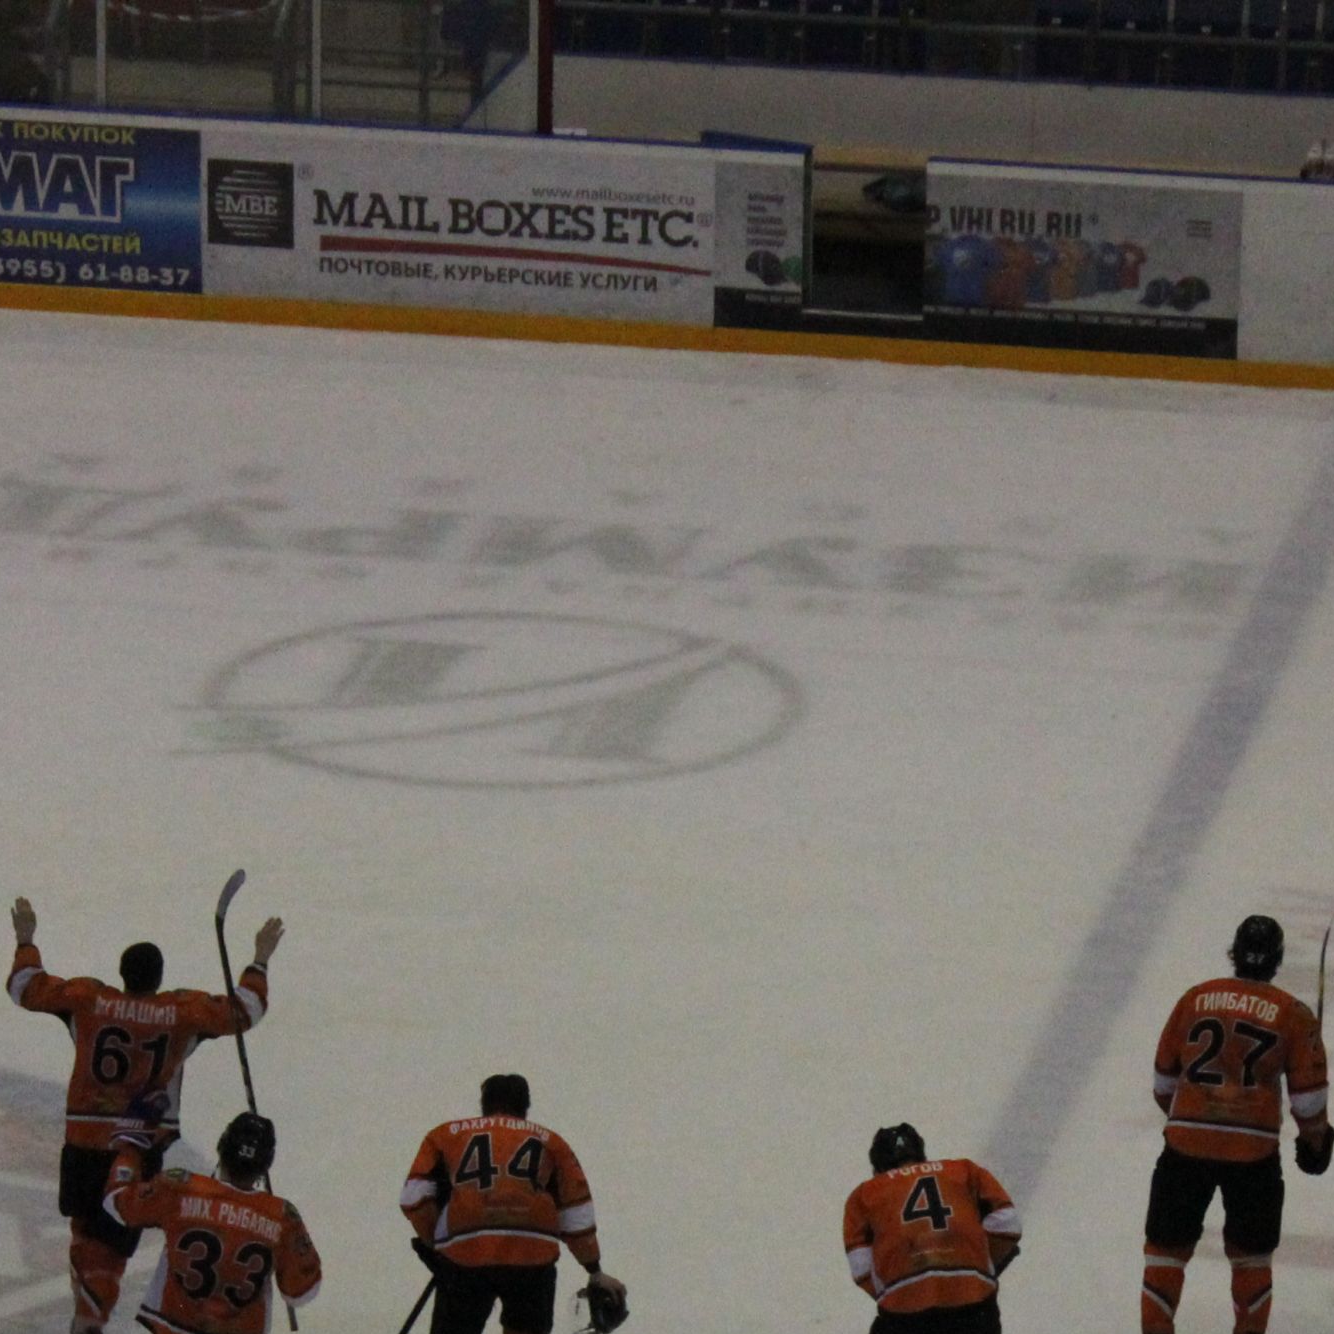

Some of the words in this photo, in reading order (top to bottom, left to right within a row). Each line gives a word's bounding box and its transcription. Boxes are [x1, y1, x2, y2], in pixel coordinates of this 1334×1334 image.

[13, 122, 136, 146] ПОКУПОК
[313, 189, 440, 232] MAIL
[448, 199, 596, 241] BOXES
[601, 206, 699, 248] ETC.
[319, 256, 437, 283] ПОЧТОВЫЕ,
[443, 262, 575, 289] КУРЬЕРСКИЕ
[579, 269, 658, 293] УСЛУГИ
[90, 1024, 170, 1090] 61
[1186, 1016, 1280, 1088] 27
[451, 1131, 544, 1192] 44
[900, 1173, 954, 1232] 4
[174, 1228, 274, 1309] 33
